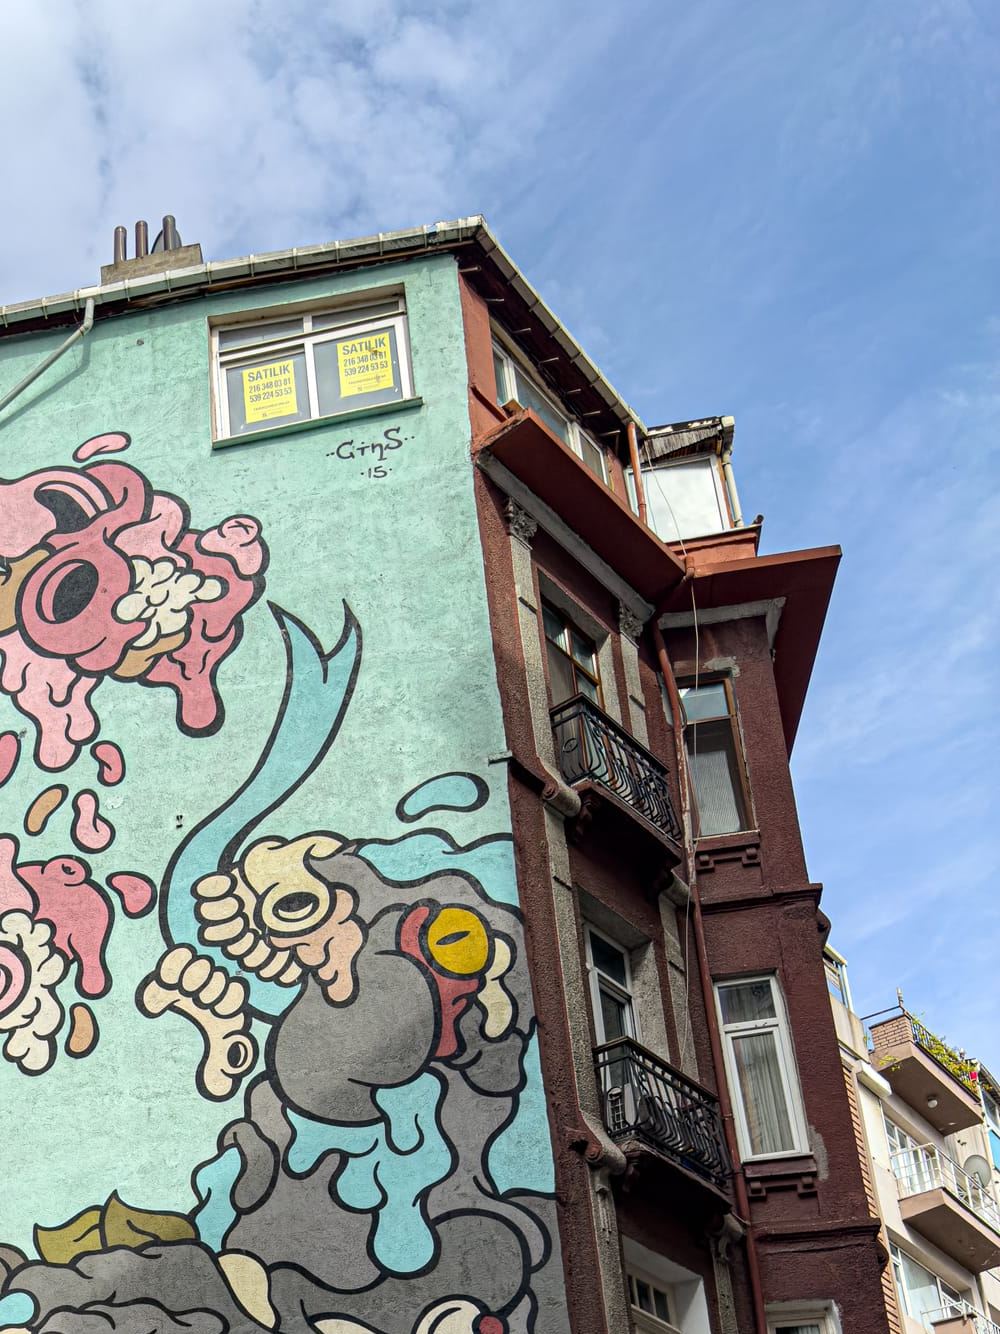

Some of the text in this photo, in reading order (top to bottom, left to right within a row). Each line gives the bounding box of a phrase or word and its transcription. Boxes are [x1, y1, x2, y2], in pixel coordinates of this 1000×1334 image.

[342, 337, 386, 356] SATILIK
[344, 357, 355, 368] 216
[247, 364, 290, 382] SATILIK
[249, 383, 260, 394] 216
